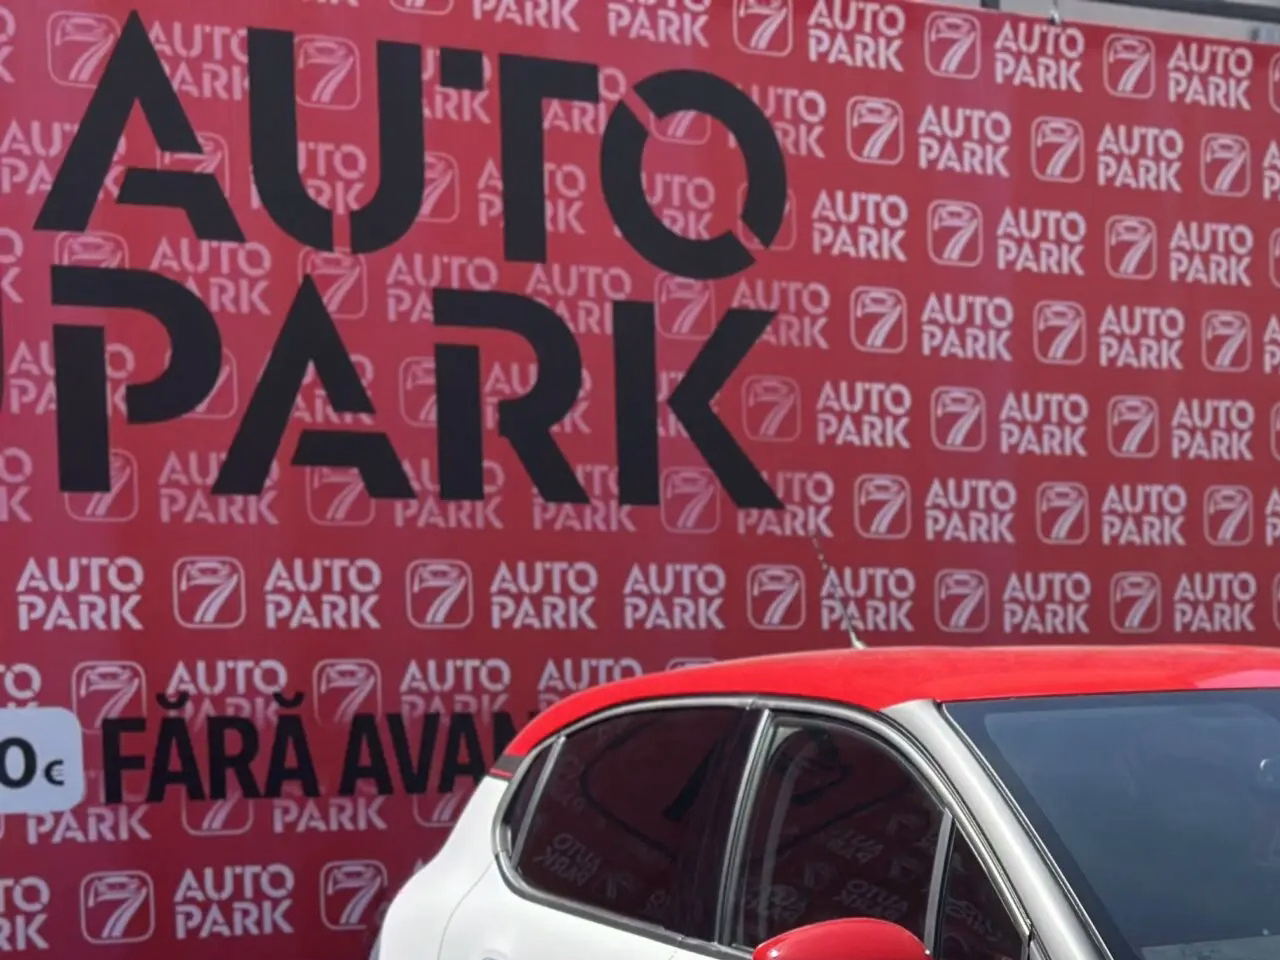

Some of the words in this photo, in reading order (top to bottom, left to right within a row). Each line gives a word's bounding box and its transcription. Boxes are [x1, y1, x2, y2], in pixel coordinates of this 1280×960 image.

[608, 4, 710, 47] PARK
[808, 0, 905, 36] AUTO
[809, 28, 903, 72] PARK
[994, 20, 1084, 58] AUTO
[995, 52, 1082, 92] PARK
[1167, 43, 1252, 77] AUTO
[748, 85, 827, 124] UTO
[1168, 70, 1250, 110] PARK
[918, 105, 1011, 143] AUTO
[1097, 124, 1183, 159] AUTO
[33, 9, 787, 281] AUTO
[919, 137, 1009, 177] PARK
[1098, 155, 1181, 192] PARK
[812, 190, 908, 227] AUTO
[997, 208, 1086, 242] AUTO
[813, 222, 906, 261] PARK
[1170, 221, 1253, 254] AUTO
[149, 236, 272, 277] AUTO
[386, 253, 499, 291] AUTO
[998, 238, 1084, 275] PARK
[1170, 250, 1250, 286] PARK
[525, 262, 632, 299] AUTO
[731, 278, 831, 315] AUTO
[921, 294, 1013, 328] AUTO
[1099, 306, 1184, 338] AUTO
[757, 314, 829, 349] ARK
[922, 324, 1011, 361] PARK
[1100, 336, 1182, 369] PARK
[50, 264, 787, 510] PARK
[817, 381, 911, 415] AUTO
[1000, 392, 1088, 424] AUTO
[1172, 399, 1254, 430] AUTO
[818, 413, 909, 448] PARK
[1000, 422, 1086, 456] PARK
[1172, 429, 1252, 460] PARK
[925, 478, 1016, 510] AUTO
[1102, 484, 1186, 514] AUTO
[926, 509, 1014, 542] PARK
[1103, 515, 1184, 545] PARK
[16, 557, 143, 592] AUTO
[264, 559, 381, 592] AUTO
[490, 562, 598, 594] AUTO
[624, 564, 725, 596] AUTO
[820, 567, 915, 599] AUTO
[1003, 572, 1091, 602] AUTO
[1174, 572, 1256, 602] AUTO
[18, 594, 142, 630] PARK
[266, 593, 380, 629] PARK
[492, 595, 597, 628] PARK
[625, 597, 724, 629] PARK
[822, 598, 913, 632] PARK
[1004, 602, 1089, 633] PARK
[1175, 602, 1254, 632] PARK
[166, 660, 288, 696] AUTO
[400, 659, 511, 692] AUTO
[102, 691, 321, 804] FĂRĂ
[27, 804, 151, 845] PARK
[273, 797, 387, 833] PARK
[174, 864, 294, 902] AUTO
[176, 899, 292, 939] PARK
